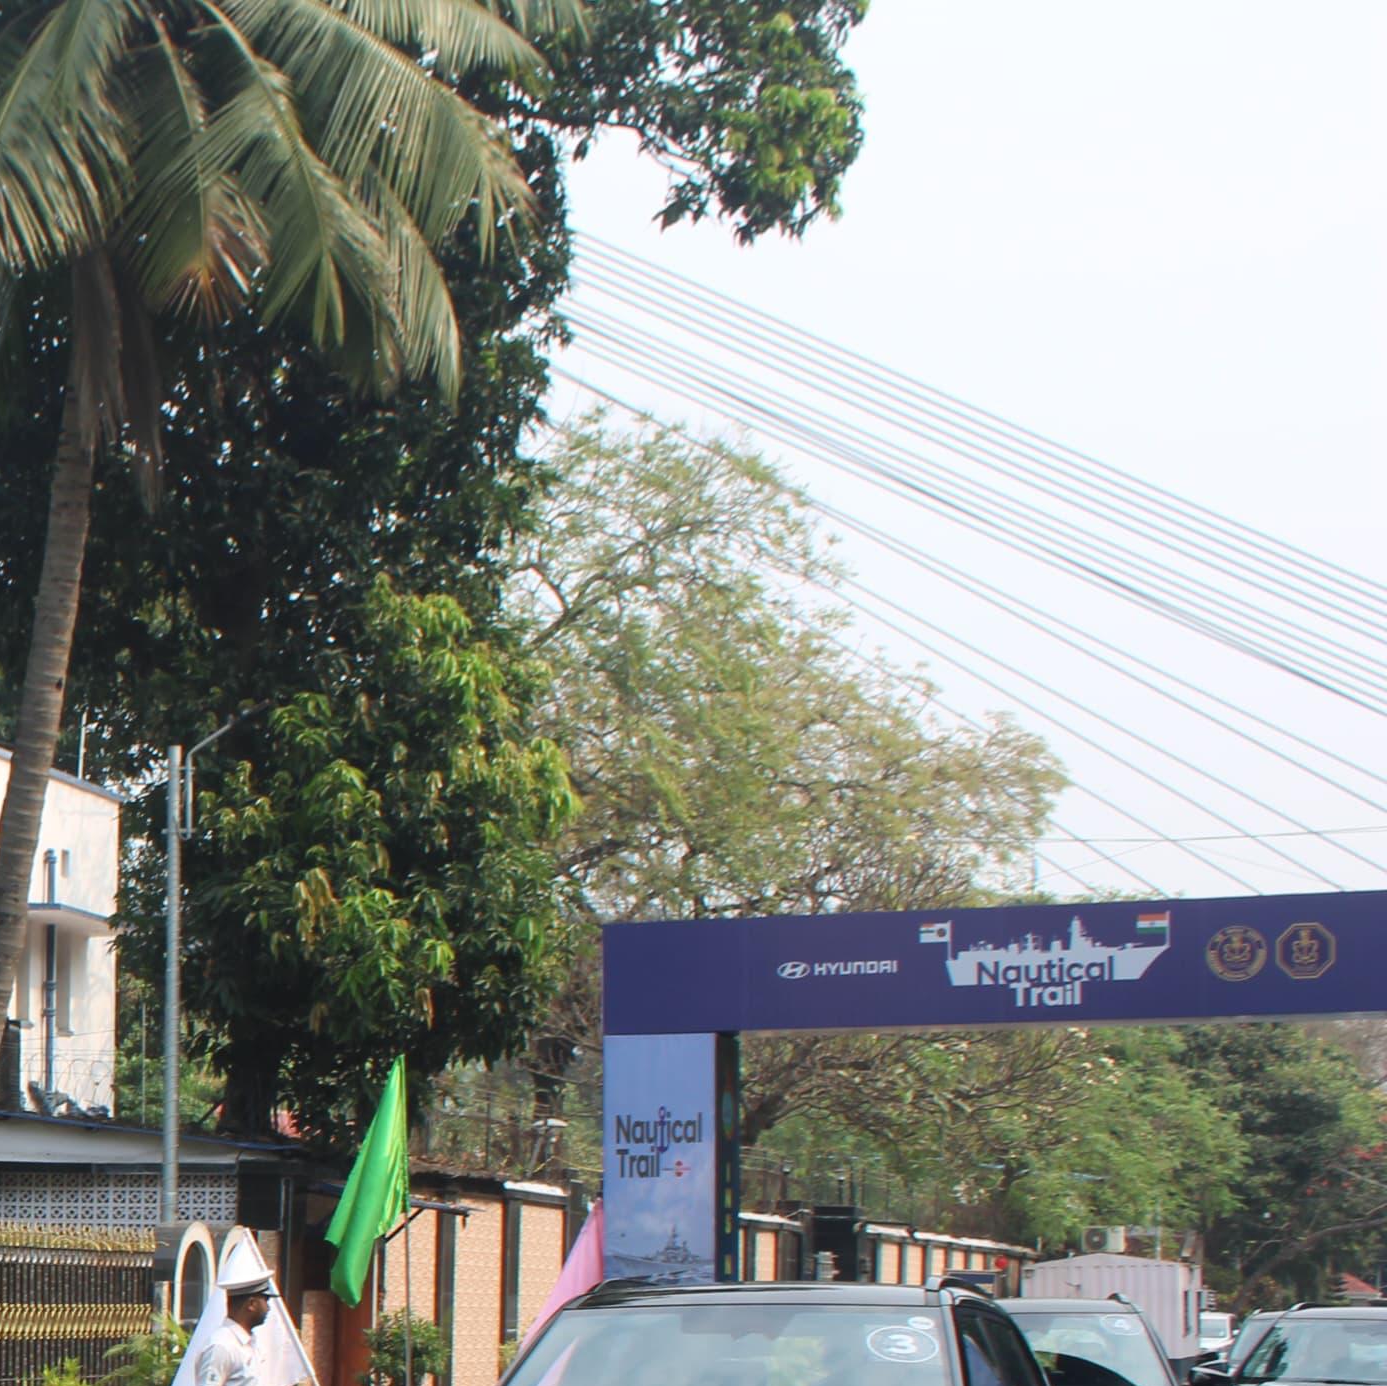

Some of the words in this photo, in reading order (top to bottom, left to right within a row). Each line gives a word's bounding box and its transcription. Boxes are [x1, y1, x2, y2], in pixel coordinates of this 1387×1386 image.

[814, 959, 898, 977] HYUNDAI
[976, 954, 1115, 986] Nautical
[1008, 981, 1082, 1007] Trail
[615, 1106, 704, 1149] Nautical
[615, 1149, 661, 1178] Trail
[887, 1334, 918, 1354] 3
